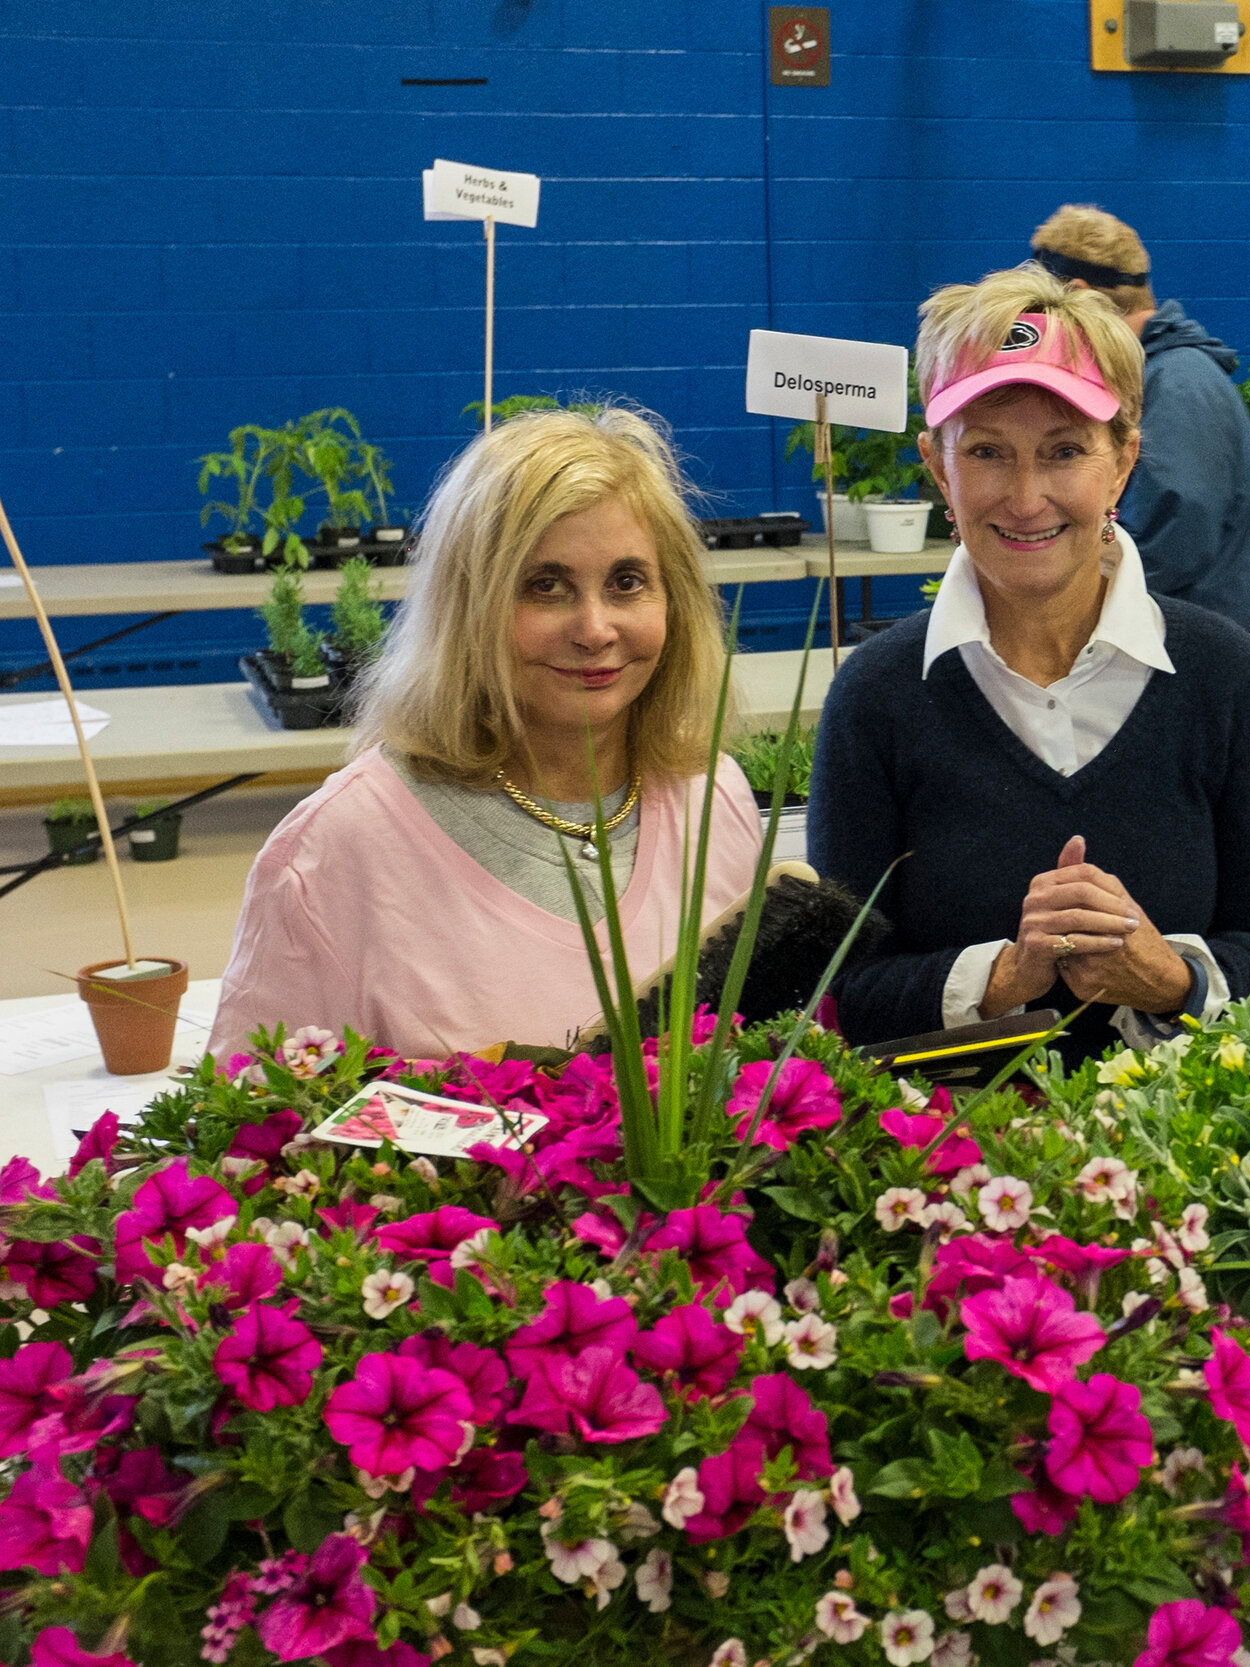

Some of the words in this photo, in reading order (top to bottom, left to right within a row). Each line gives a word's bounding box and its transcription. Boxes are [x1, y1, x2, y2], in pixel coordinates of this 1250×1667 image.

[464, 174, 495, 190] Herbs
[499, 181, 507, 192] &
[455, 188, 514, 209] Vegetables
[774, 371, 876, 399] Delosperma
